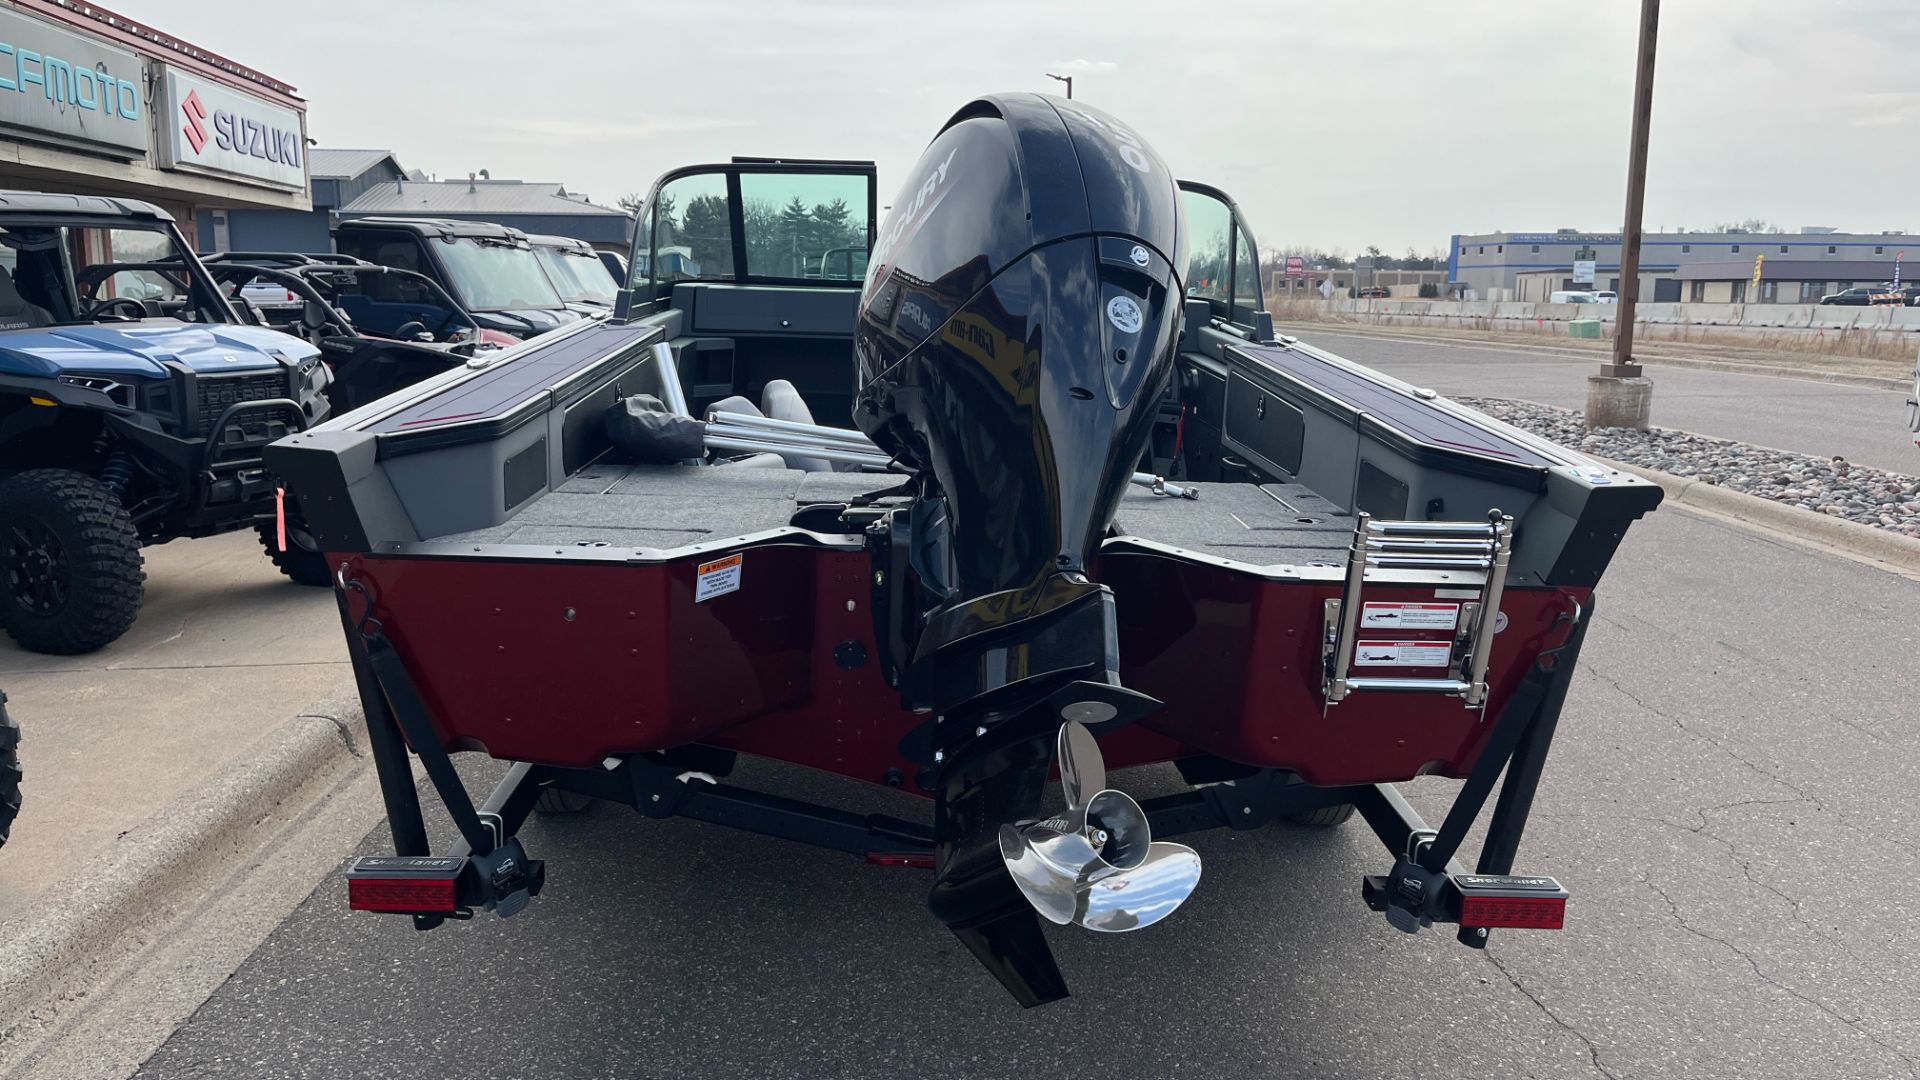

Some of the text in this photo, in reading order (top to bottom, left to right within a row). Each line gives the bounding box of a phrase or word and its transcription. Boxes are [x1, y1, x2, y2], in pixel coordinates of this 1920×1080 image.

[214, 108, 301, 168] SUZUKI
[207, 386, 281, 403] POLARIS
[712, 558, 736, 569] WARNING
